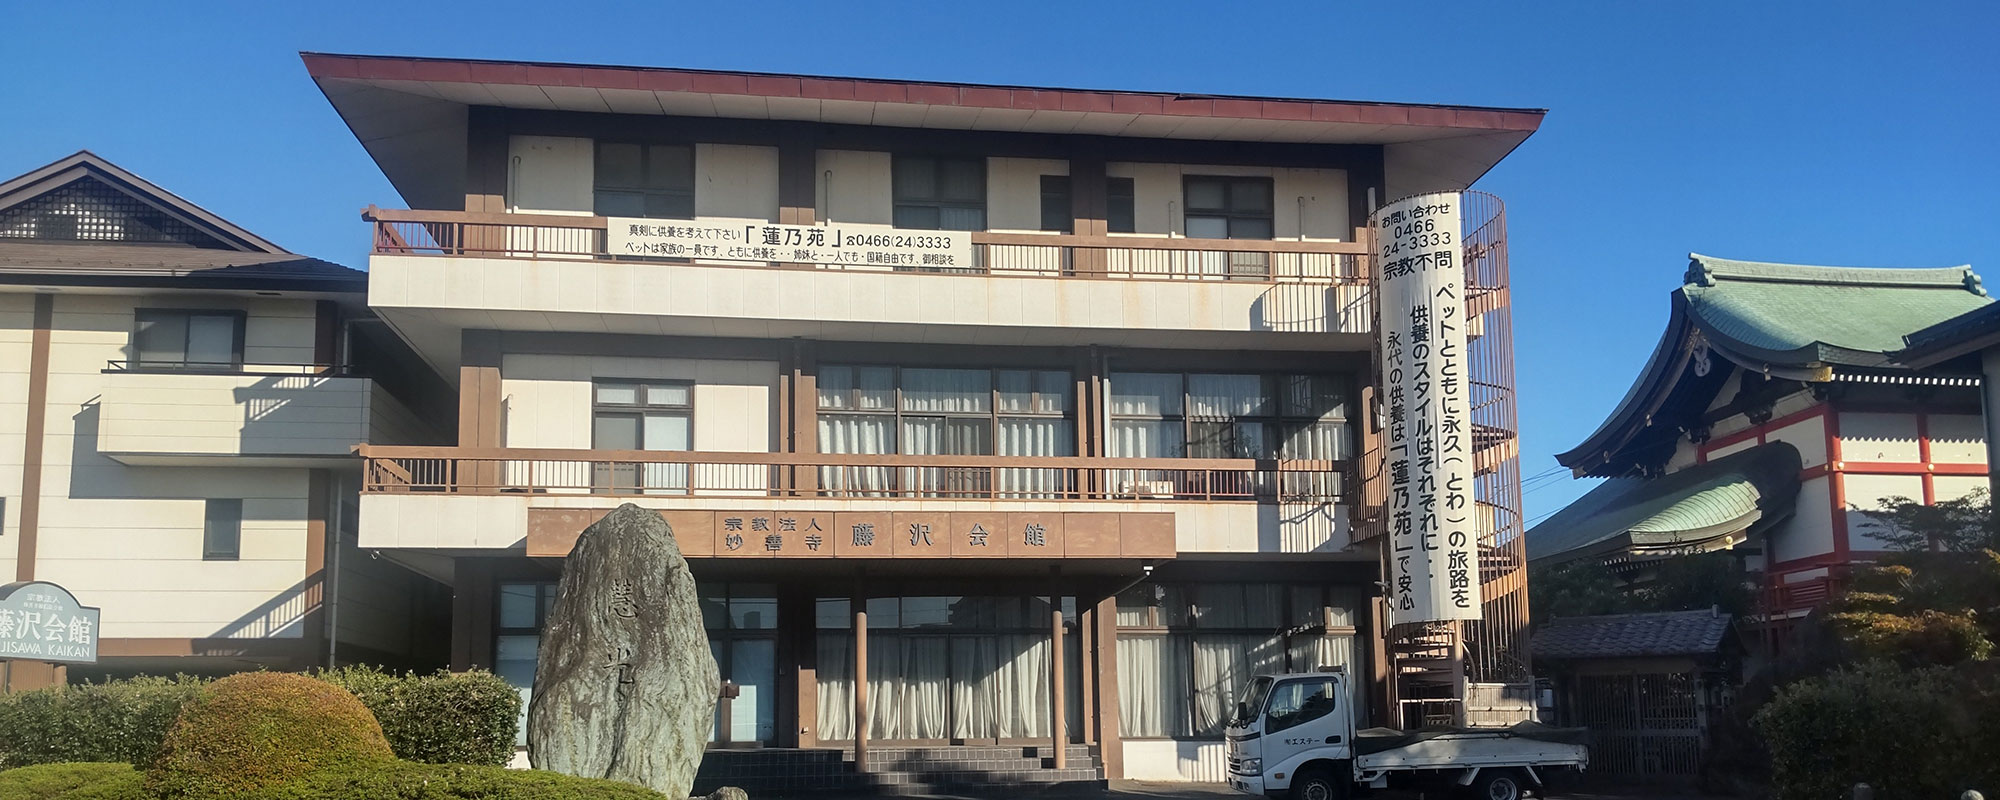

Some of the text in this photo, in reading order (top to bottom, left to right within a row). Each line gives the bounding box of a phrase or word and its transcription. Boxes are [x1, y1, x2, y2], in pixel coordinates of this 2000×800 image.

[1382, 203, 1450, 228] お問い合わせ
[629, 224, 741, 240] 真剣に供養を考えて下さい
[856, 234, 951, 249] 0466(24)3333
[1394, 219, 1434, 239] 0466
[1383, 232, 1451, 258] 24-3333
[1384, 251, 1453, 281] 宗教不問
[724, 517, 822, 531] 宗教法人
[851, 523, 1046, 547] 藤沢会館
[725, 534, 822, 551] 妙善寺
[48, 644, 90, 657] KAIKAN
